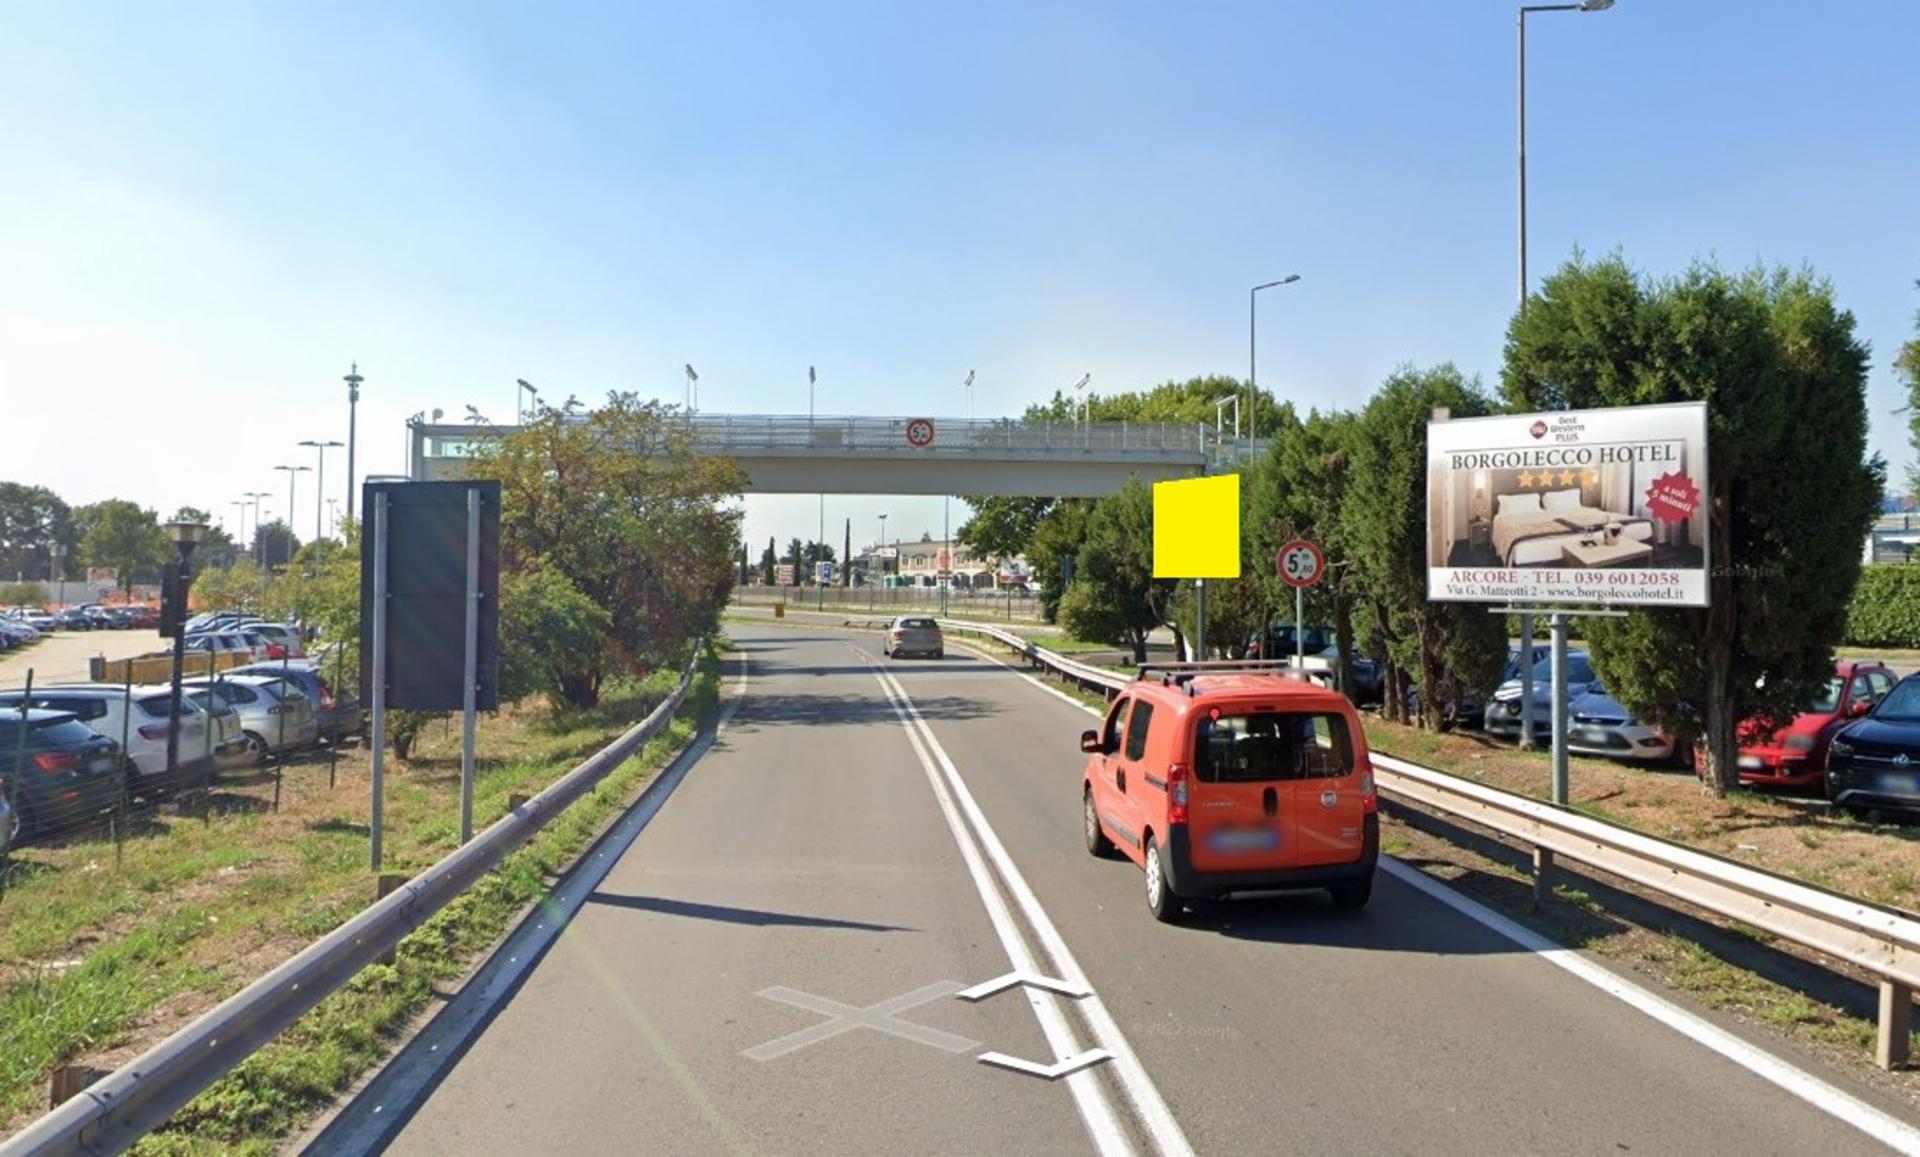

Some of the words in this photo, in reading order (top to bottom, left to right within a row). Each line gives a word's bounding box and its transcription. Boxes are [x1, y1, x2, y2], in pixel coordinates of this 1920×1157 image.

[1558, 416, 1577, 425] Best
[1551, 424, 1584, 433] Western
[1452, 447, 1594, 470] BORGOLECCO
[1601, 445, 1678, 463] HOTEL
[1288, 553, 1298, 573] 5
[1451, 571, 1518, 583] ARCORE
[1532, 572, 1569, 584] TEL.
[1575, 572, 1607, 584] 039
[1608, 572, 1680, 585] 6012058
[1447, 585, 1464, 595] Via
[1465, 586, 1478, 596] G.
[1481, 585, 1528, 597] Matteotti
[1530, 586, 1538, 596] 2
[1547, 586, 1684, 602] www.borgoleccohotel.it
